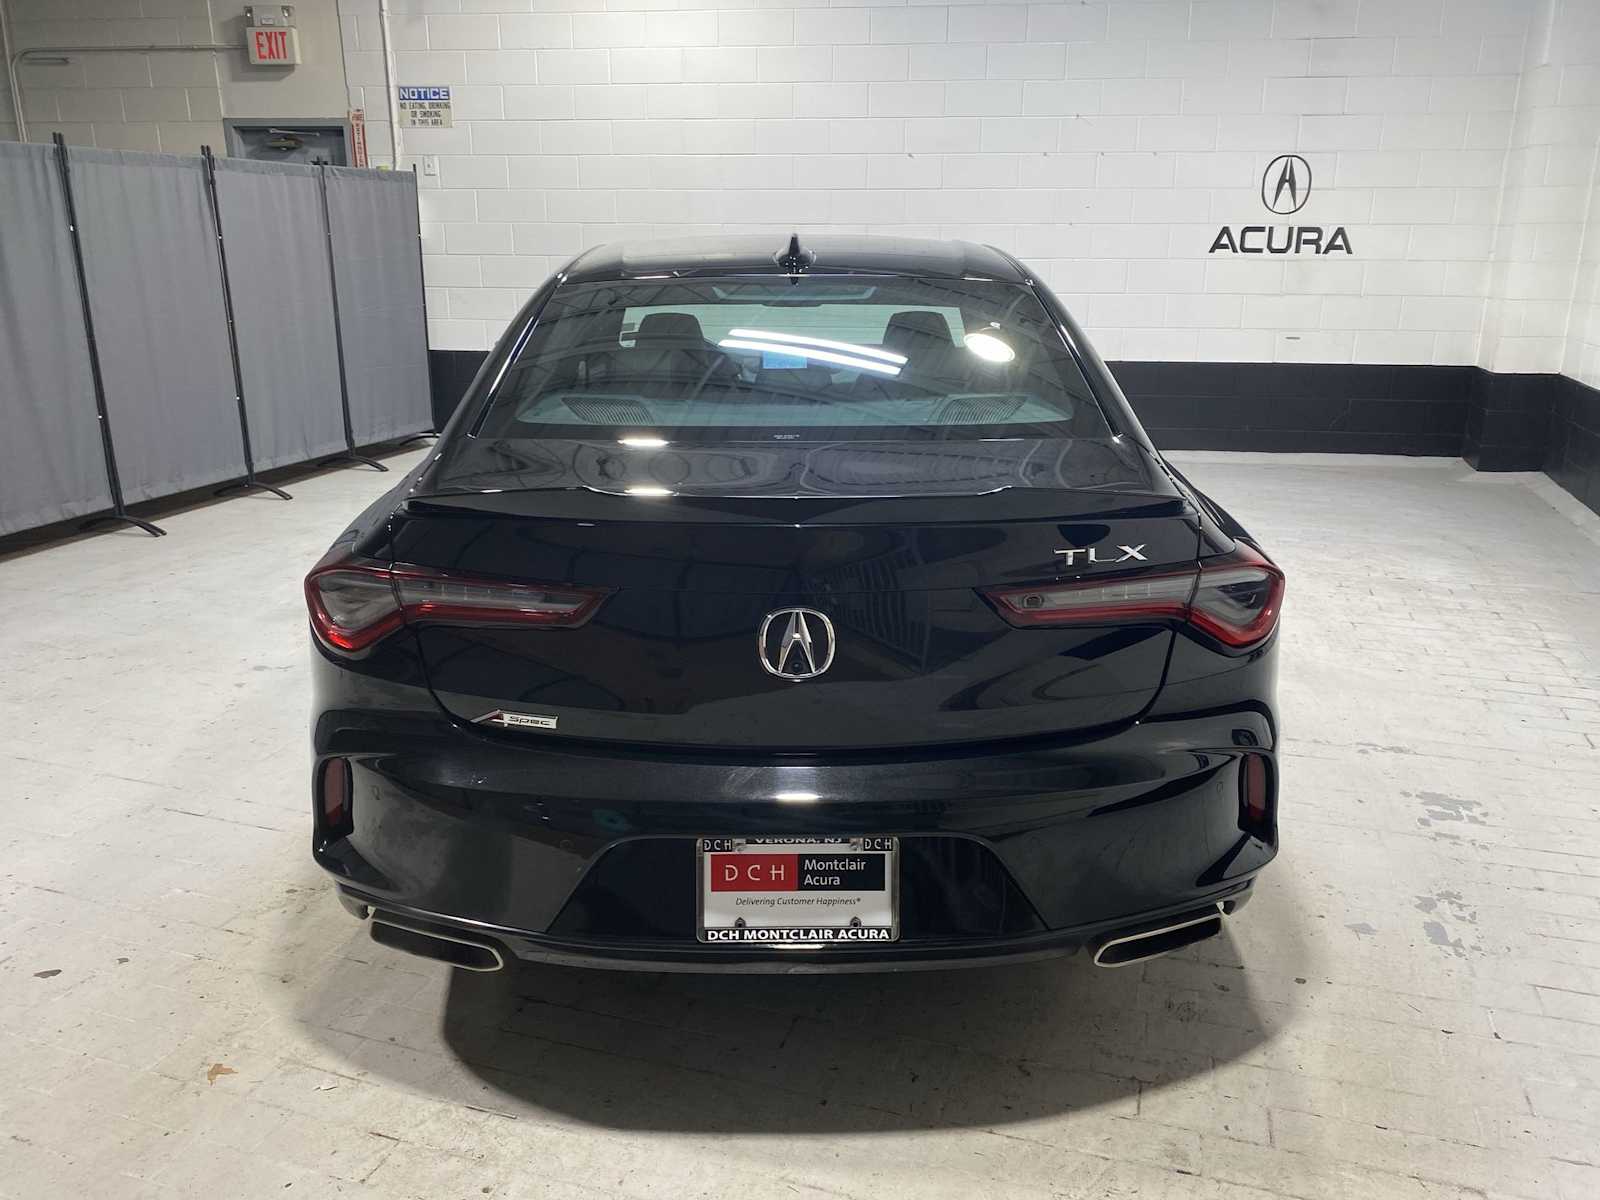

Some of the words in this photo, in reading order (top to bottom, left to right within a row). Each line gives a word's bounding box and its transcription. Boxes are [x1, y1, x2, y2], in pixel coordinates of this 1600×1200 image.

[255, 31, 287, 59] EXIT
[400, 87, 449, 99] NOTICE
[410, 110, 417, 118] OR
[420, 110, 441, 118] SMOKING
[431, 118, 443, 126] AREA
[1208, 226, 1352, 254] ACURA
[1053, 543, 1147, 566] TLX
[703, 839, 732, 851] DCH
[864, 838, 892, 850] DCH
[804, 858, 866, 871] Montclair
[804, 874, 840, 886] Acura
[735, 897, 775, 907] Delivering
[777, 897, 814, 905] Customer
[707, 930, 740, 941] DCH
[743, 929, 833, 940] MONTCLAIR
[837, 929, 890, 939] ACURA
